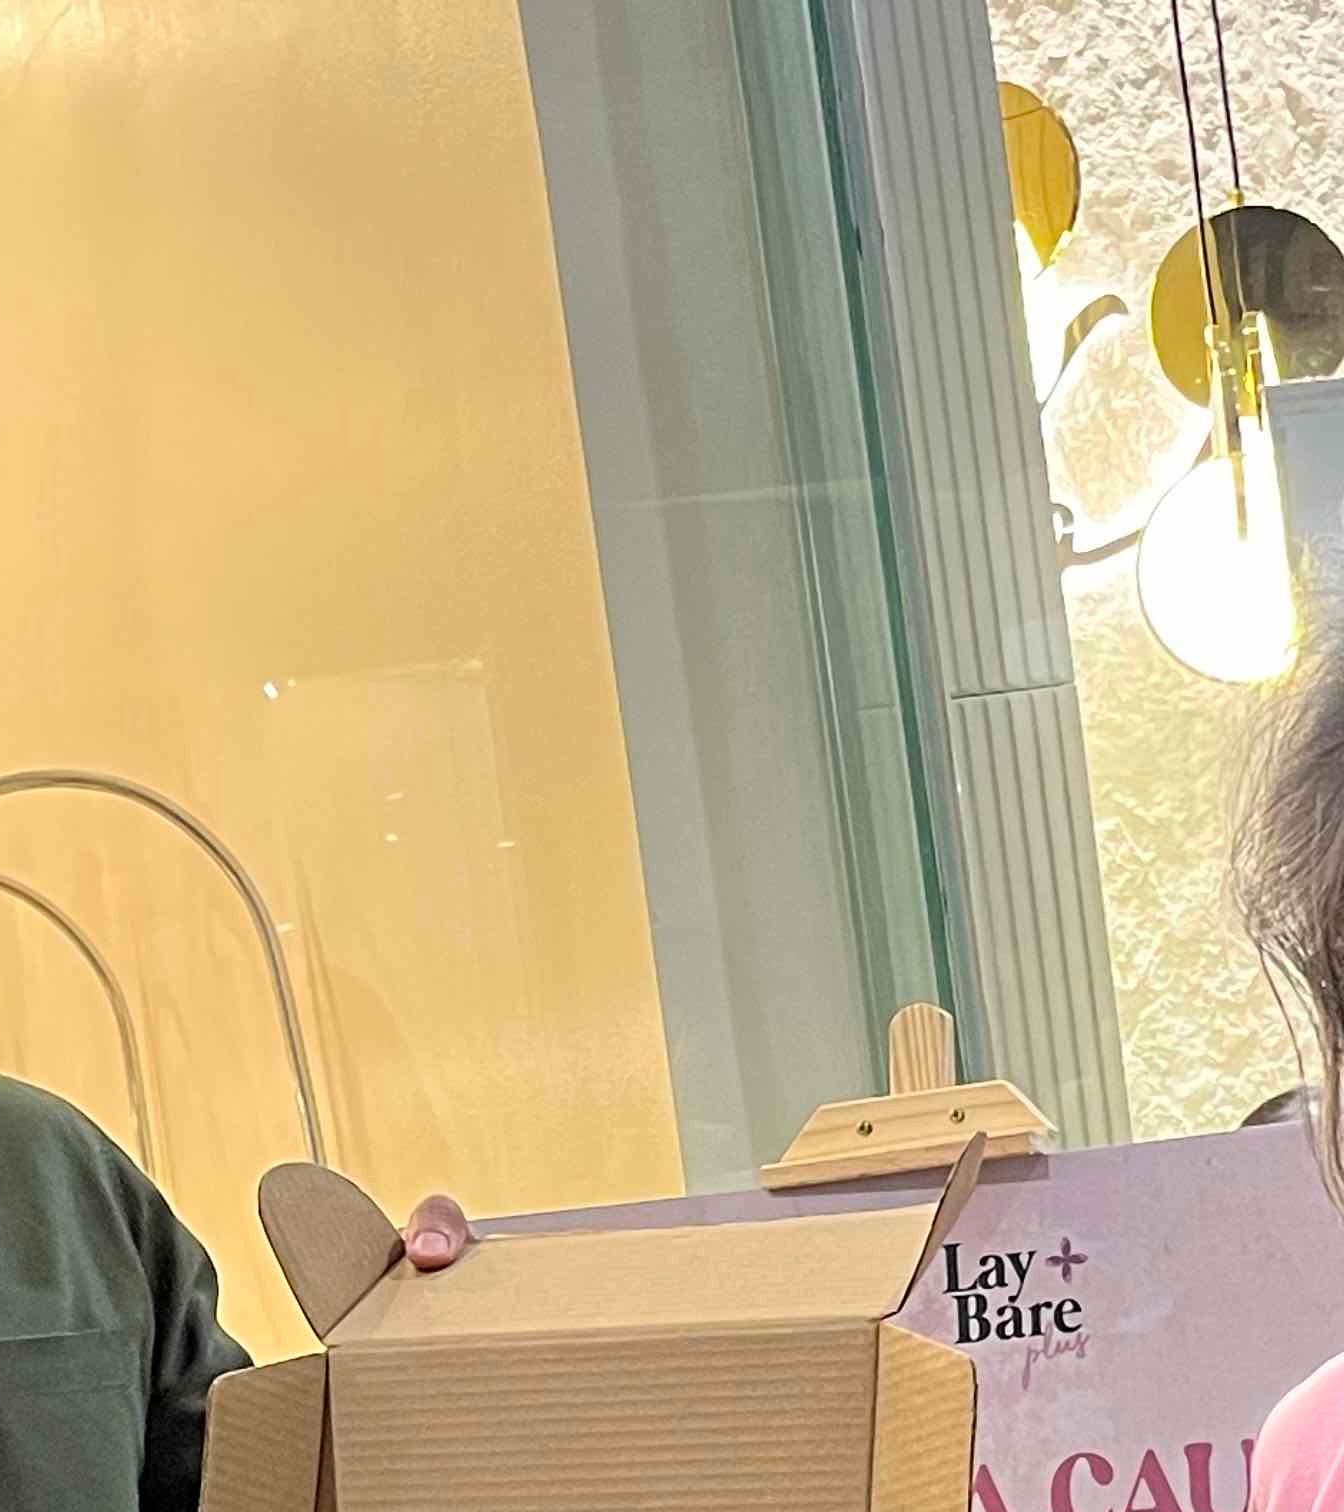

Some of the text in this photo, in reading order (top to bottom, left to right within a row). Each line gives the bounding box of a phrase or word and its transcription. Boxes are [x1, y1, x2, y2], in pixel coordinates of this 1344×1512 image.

[942, 1241, 1037, 1297] Lay
[955, 1294, 1083, 1344] Bare
[1023, 1326, 1090, 1391] plus
